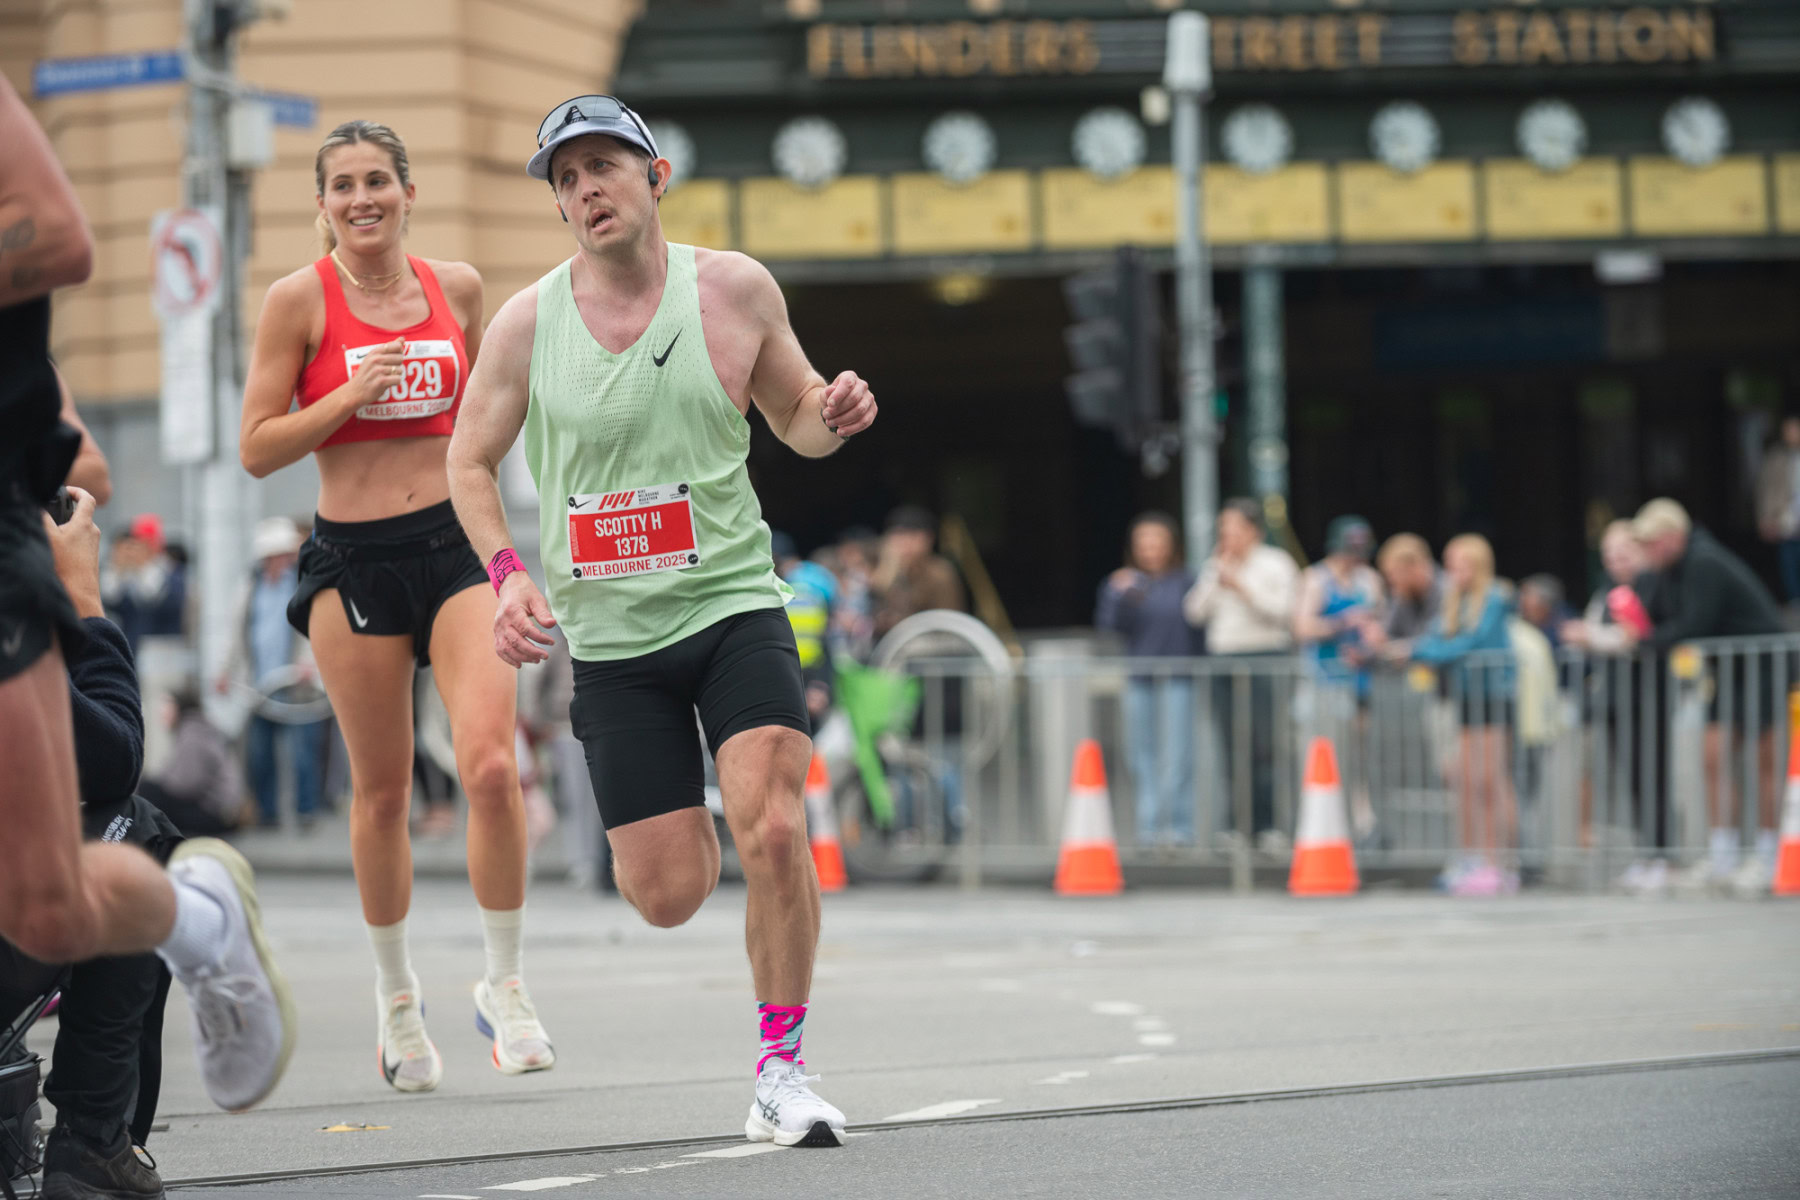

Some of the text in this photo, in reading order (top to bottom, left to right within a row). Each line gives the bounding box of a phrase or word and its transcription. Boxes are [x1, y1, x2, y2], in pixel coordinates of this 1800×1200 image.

[807, 7, 1715, 78] FLINDERS TREET STATION
[365, 404, 424, 416] MELBOURNE
[594, 511, 662, 537] SCOTTY H
[614, 535, 649, 556] 1378
[582, 553, 687, 577] MELBOURNE 2025
